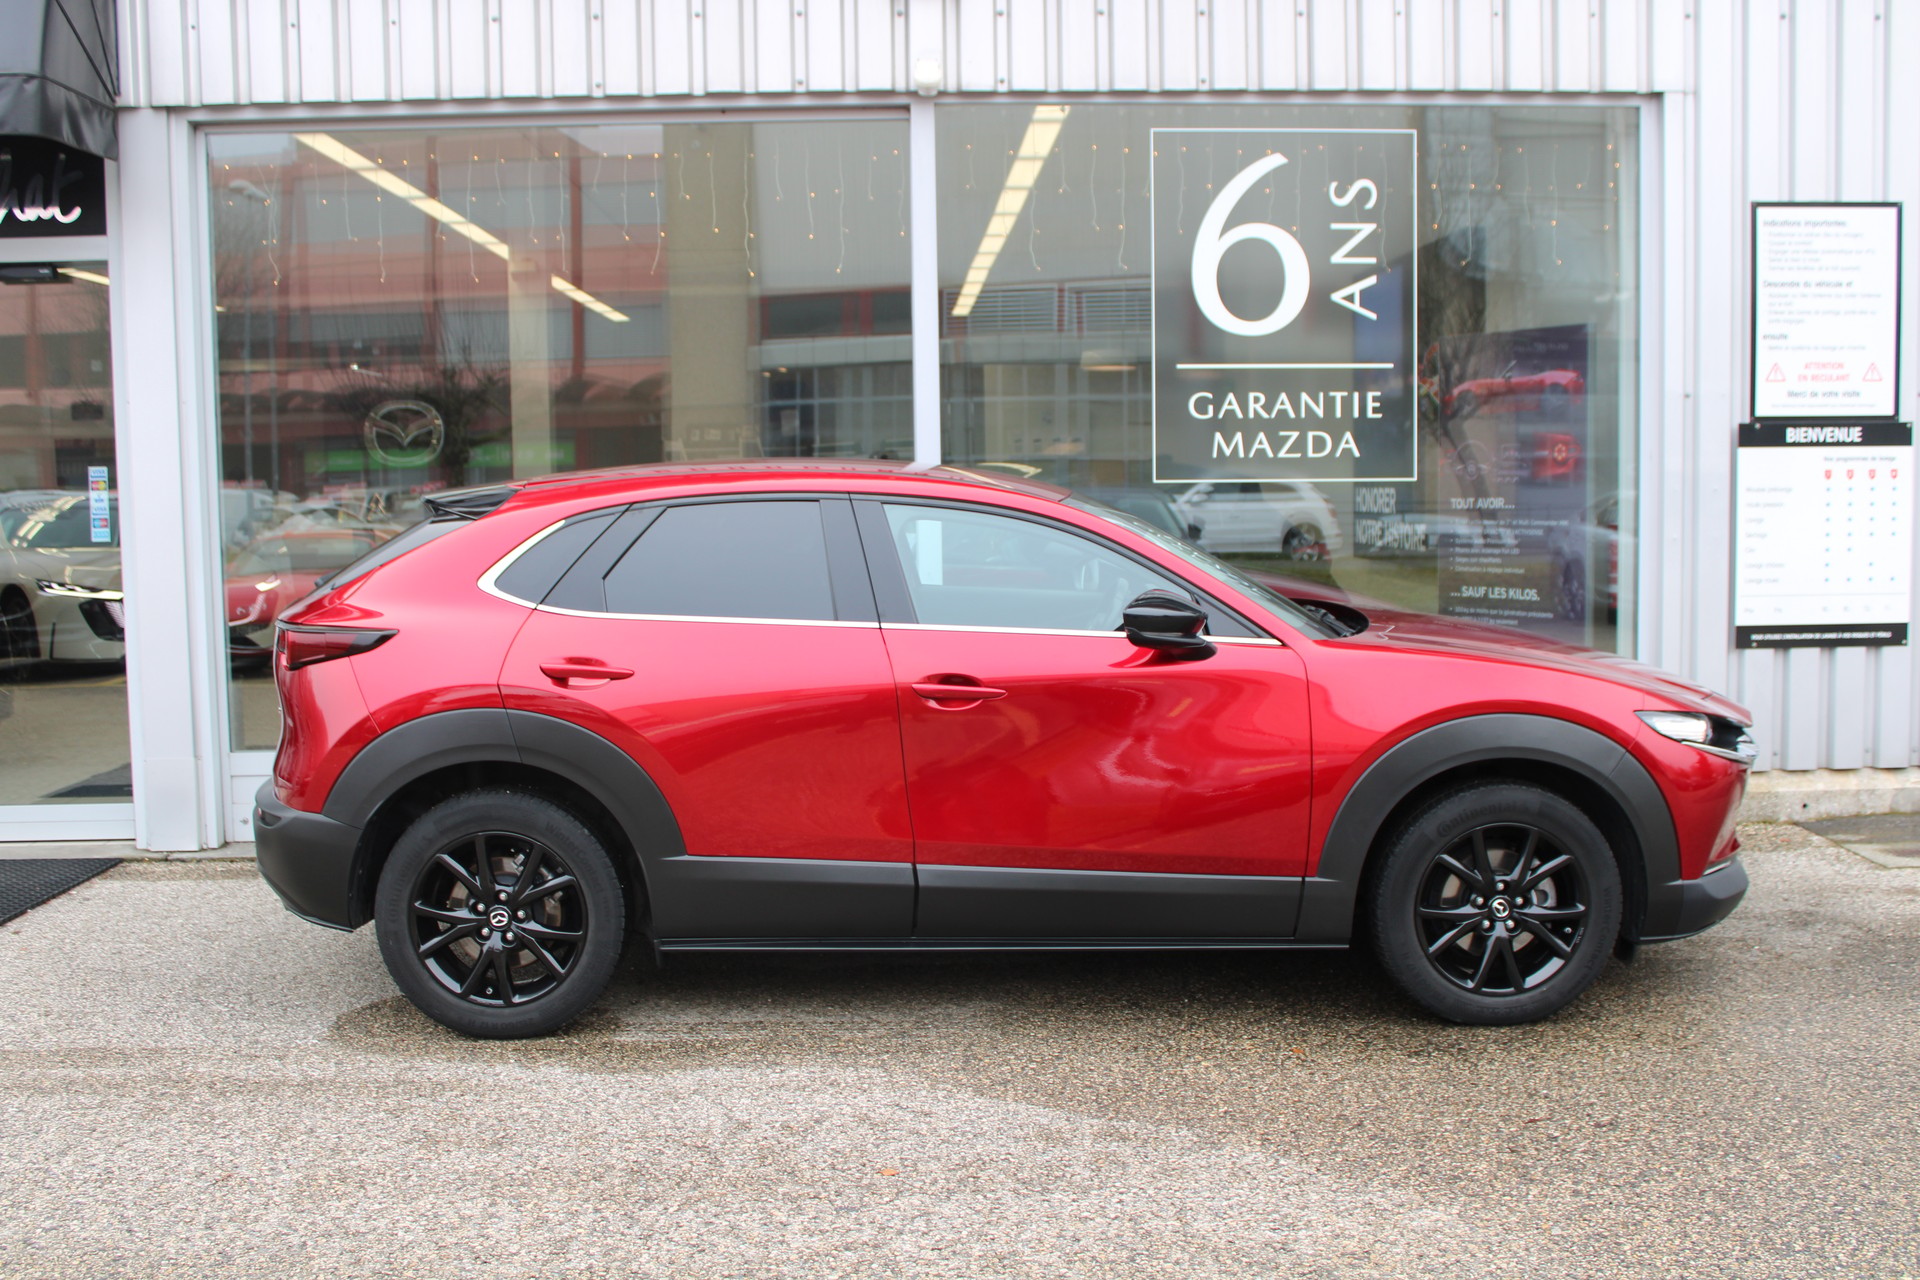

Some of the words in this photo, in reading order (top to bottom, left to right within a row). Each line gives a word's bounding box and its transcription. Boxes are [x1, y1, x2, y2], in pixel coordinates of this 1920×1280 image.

[1191, 152, 1311, 337] 6
[1328, 178, 1378, 321] ANS
[1188, 391, 1383, 419] GARANTIE
[1212, 431, 1361, 458] MAZDA
[1786, 427, 1863, 443] BIENVENUE
[1355, 487, 1396, 513] HONORER
[1450, 498, 1475, 509] TOUT
[1355, 519, 1383, 545] NOTRE
[1488, 587, 1507, 599] LES
[1508, 588, 1541, 601] KILOS.
